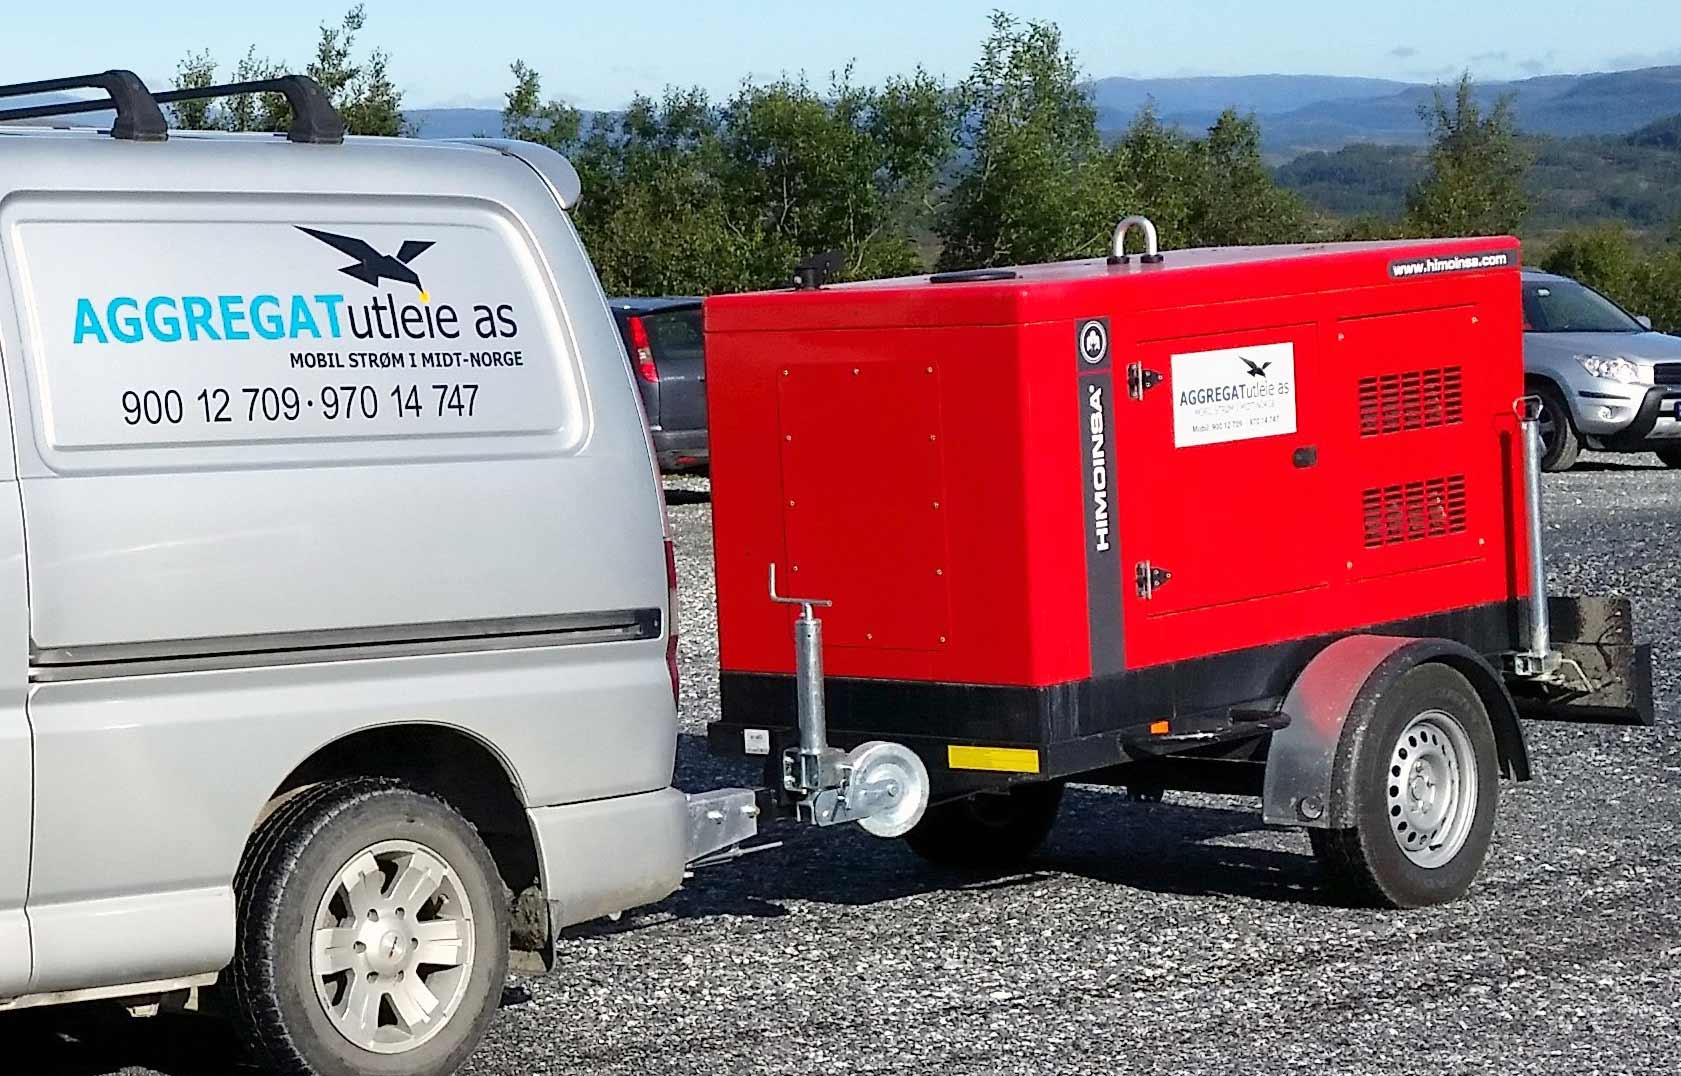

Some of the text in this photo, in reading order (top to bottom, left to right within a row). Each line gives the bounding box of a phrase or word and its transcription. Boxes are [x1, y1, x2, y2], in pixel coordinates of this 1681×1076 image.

[1392, 253, 1507, 276] www.himoinsa.com
[473, 304, 518, 338] as
[289, 351, 523, 368] MOBIL STRØM I MIDT-NORGE
[1278, 382, 1290, 395] as
[121, 389, 183, 425] 900
[197, 388, 232, 422] 12
[390, 384, 422, 418] 14
[432, 384, 479, 417] 747
[1089, 386, 1109, 551] HIMOINSA
